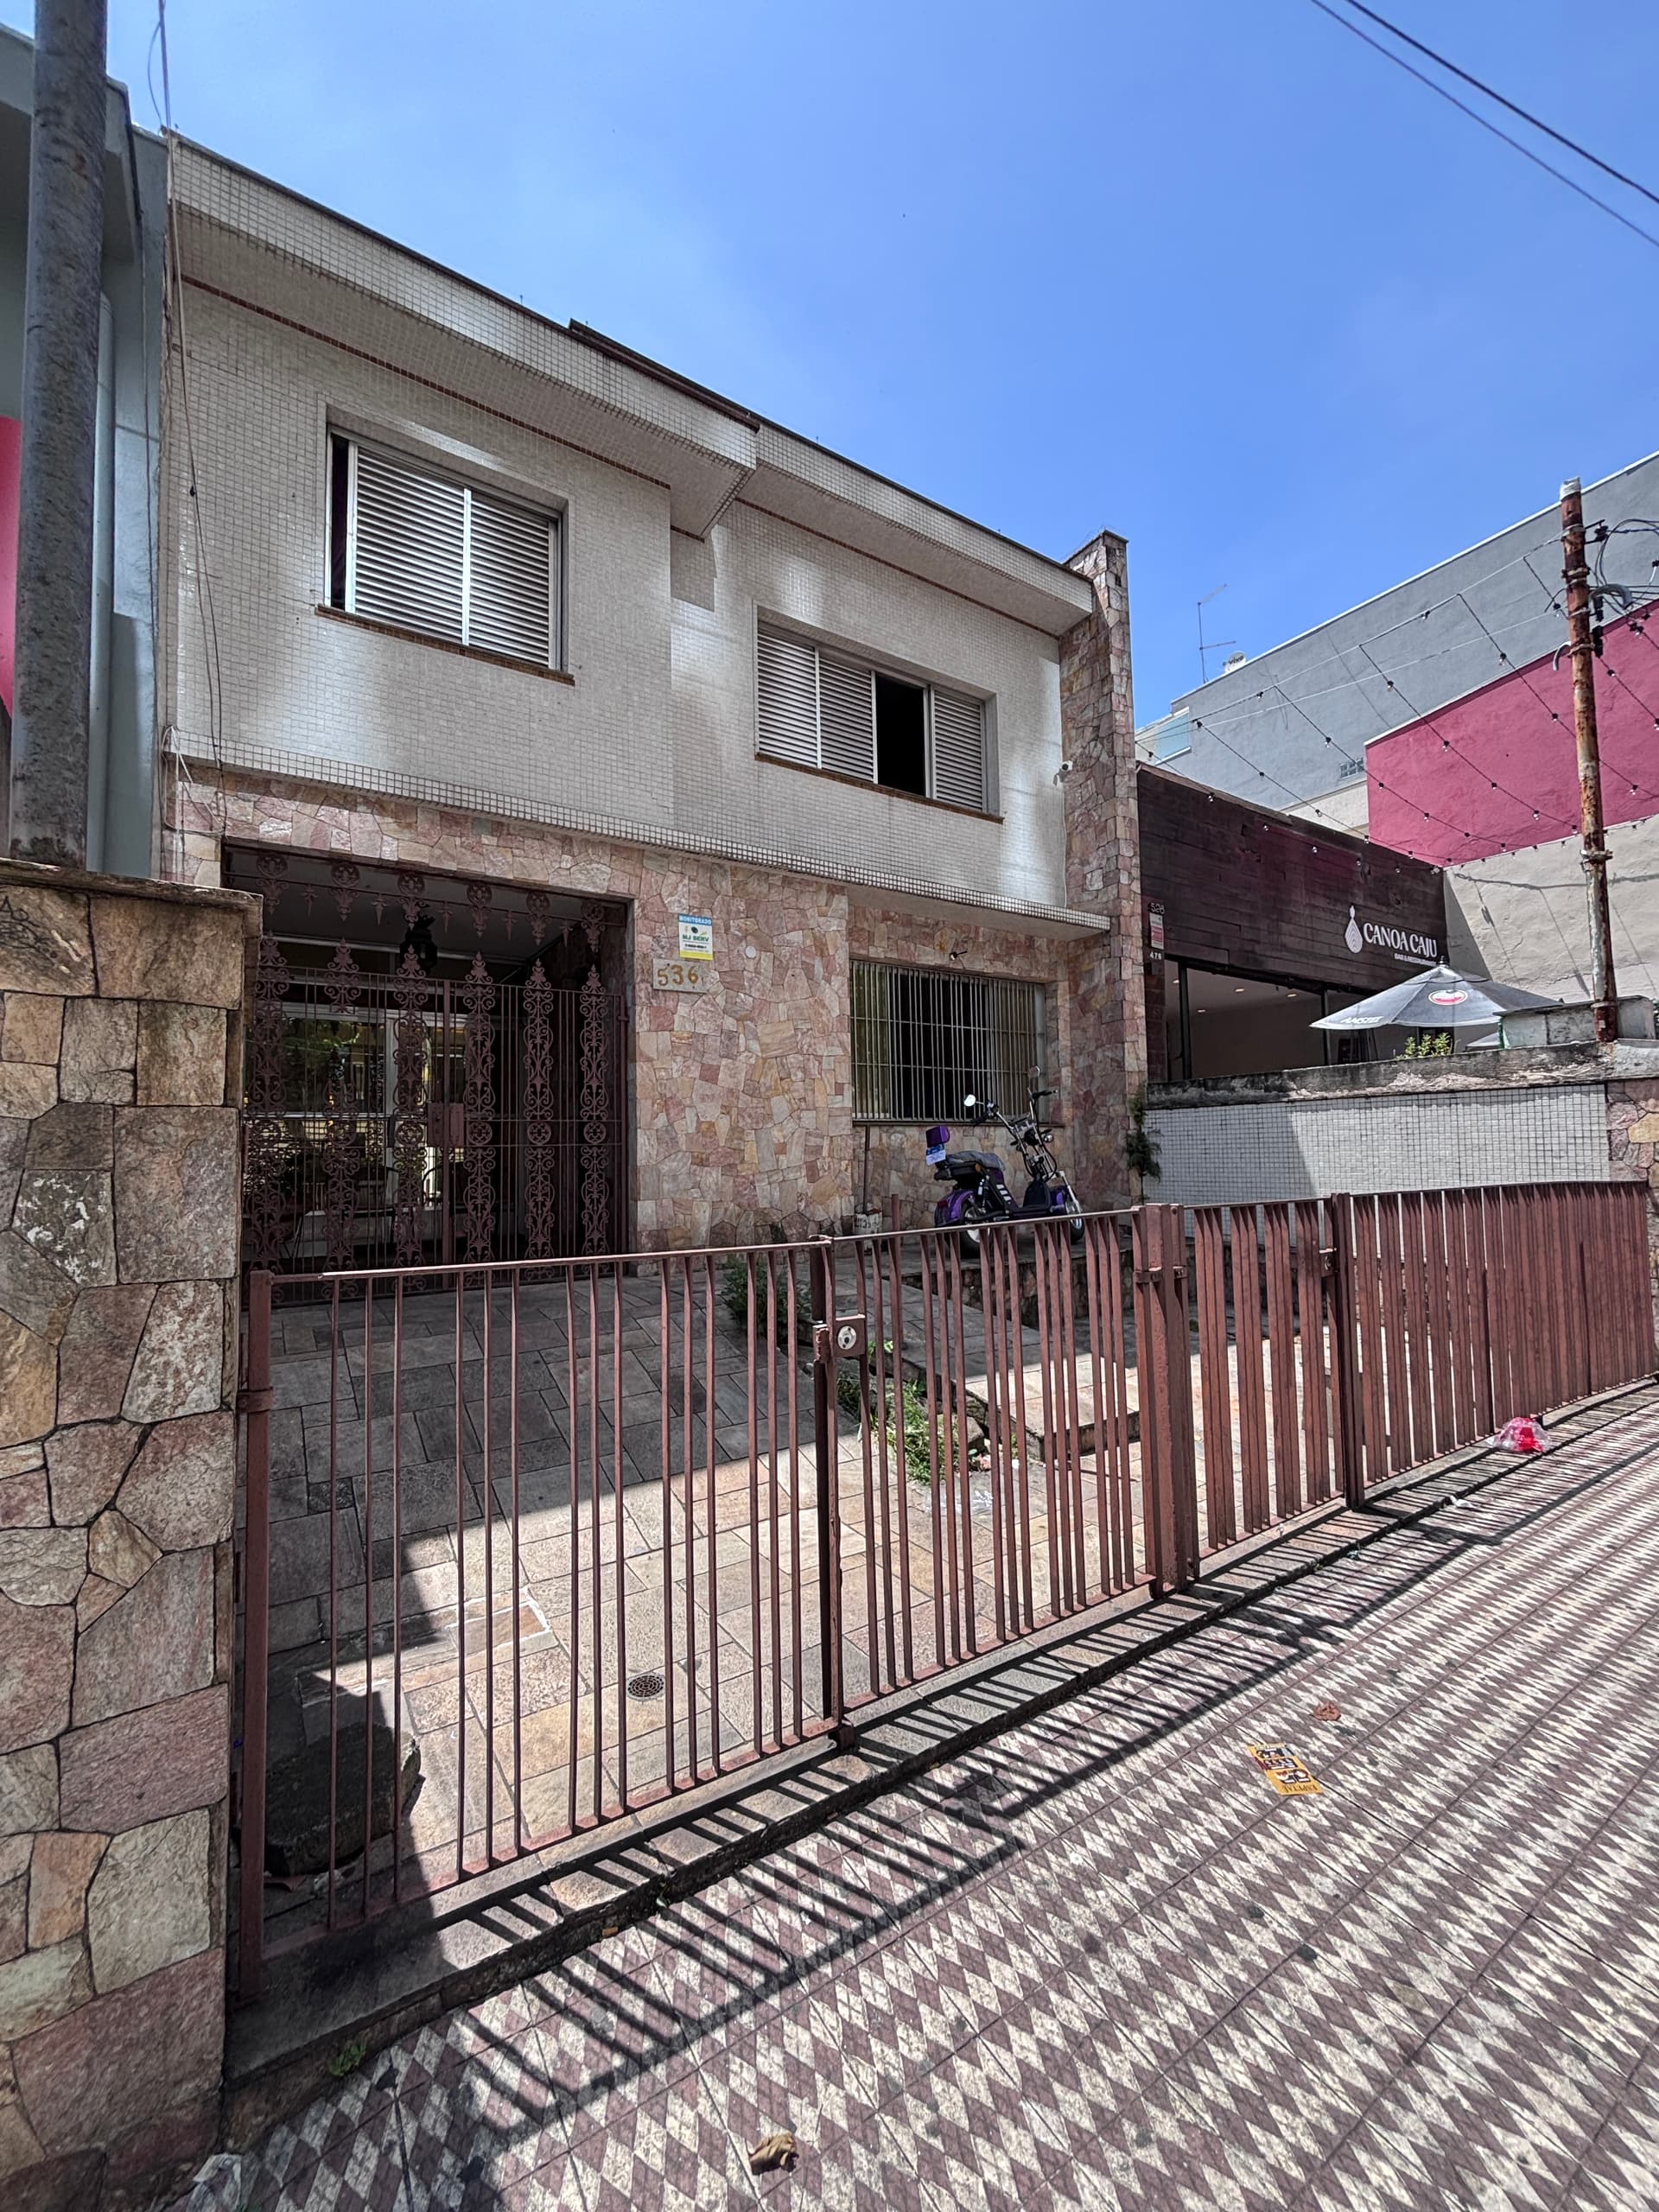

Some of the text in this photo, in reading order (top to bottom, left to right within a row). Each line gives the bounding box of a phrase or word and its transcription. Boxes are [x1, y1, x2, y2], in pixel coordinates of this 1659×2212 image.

[1363, 923, 1437, 957] CANOA CAJU
[658, 964, 699, 986] 536
